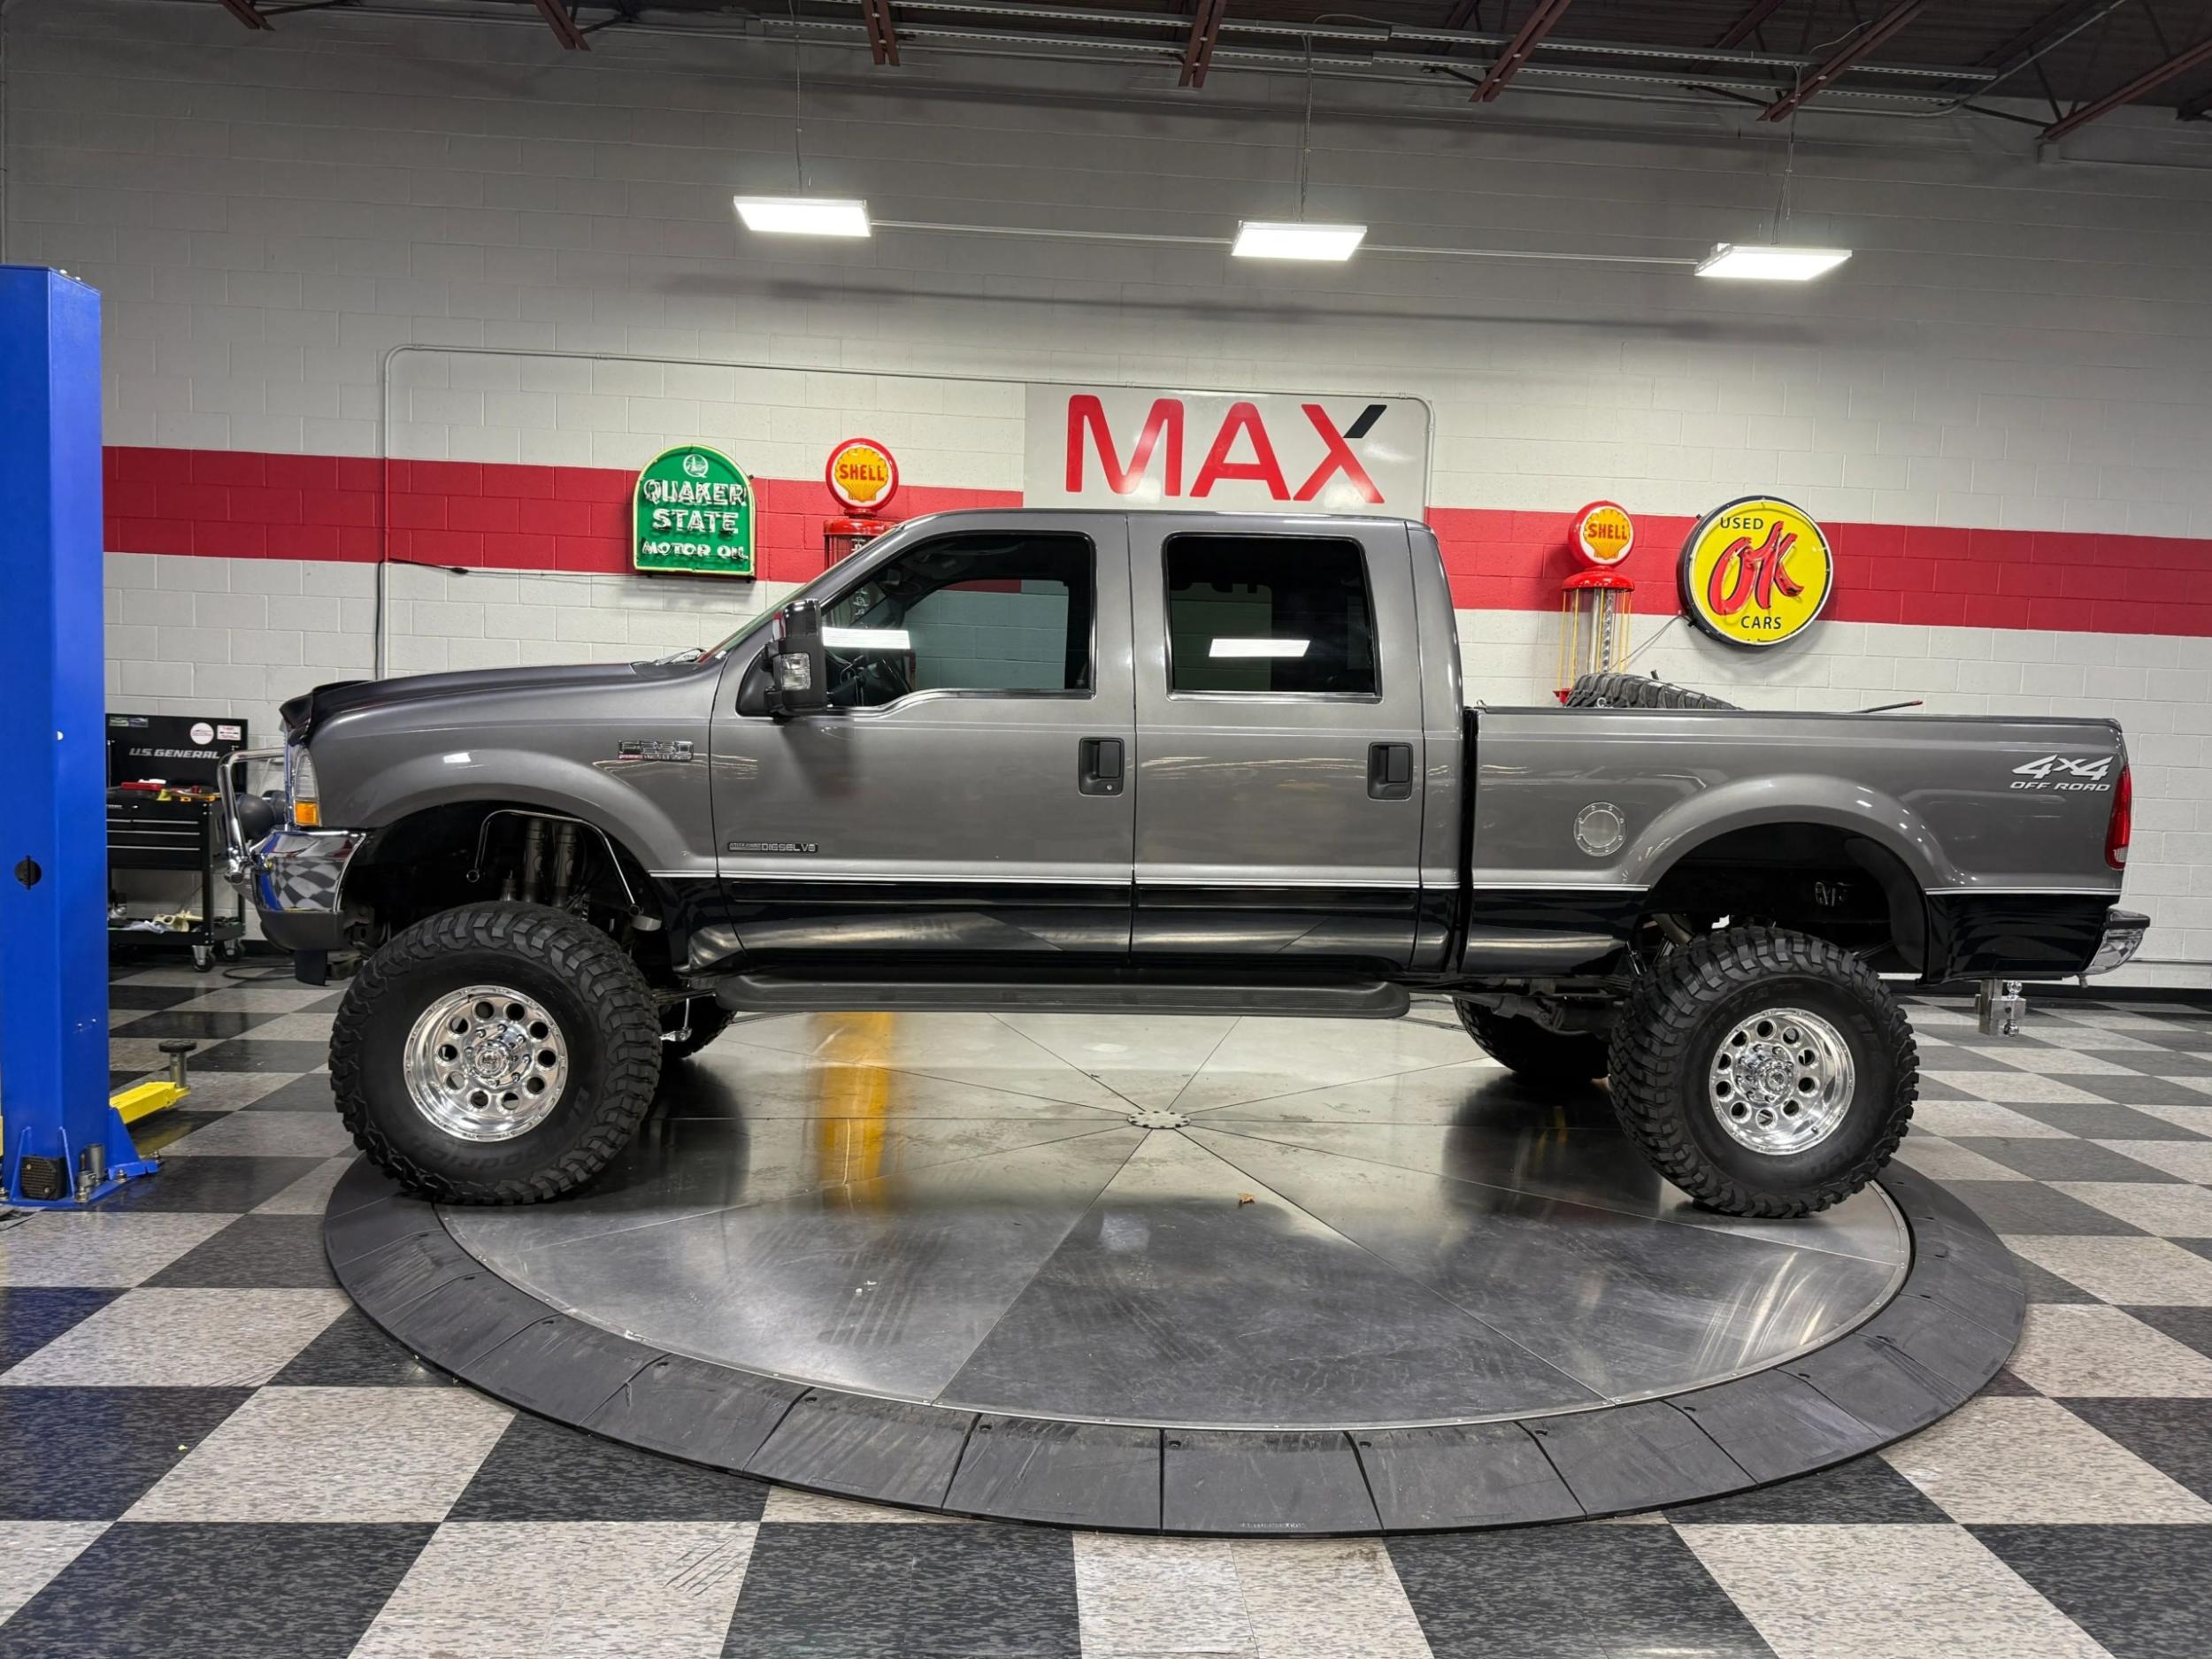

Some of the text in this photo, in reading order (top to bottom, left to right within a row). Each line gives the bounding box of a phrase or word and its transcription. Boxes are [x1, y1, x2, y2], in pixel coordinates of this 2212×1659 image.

[1065, 394, 1386, 503] MAX
[838, 464, 885, 482] SHELL
[643, 479, 748, 506] QUAKER
[652, 508, 739, 534] STATE
[1720, 517, 1763, 530] USED
[1587, 523, 1628, 541] SHELL
[641, 541, 749, 560] MOTOR OIL
[1707, 520, 1804, 616] OK
[1740, 616, 1782, 629] CARS
[154, 749, 220, 759] GENERAL
[2054, 782, 2112, 792] ROAD
[761, 842, 800, 851] DIESEL
